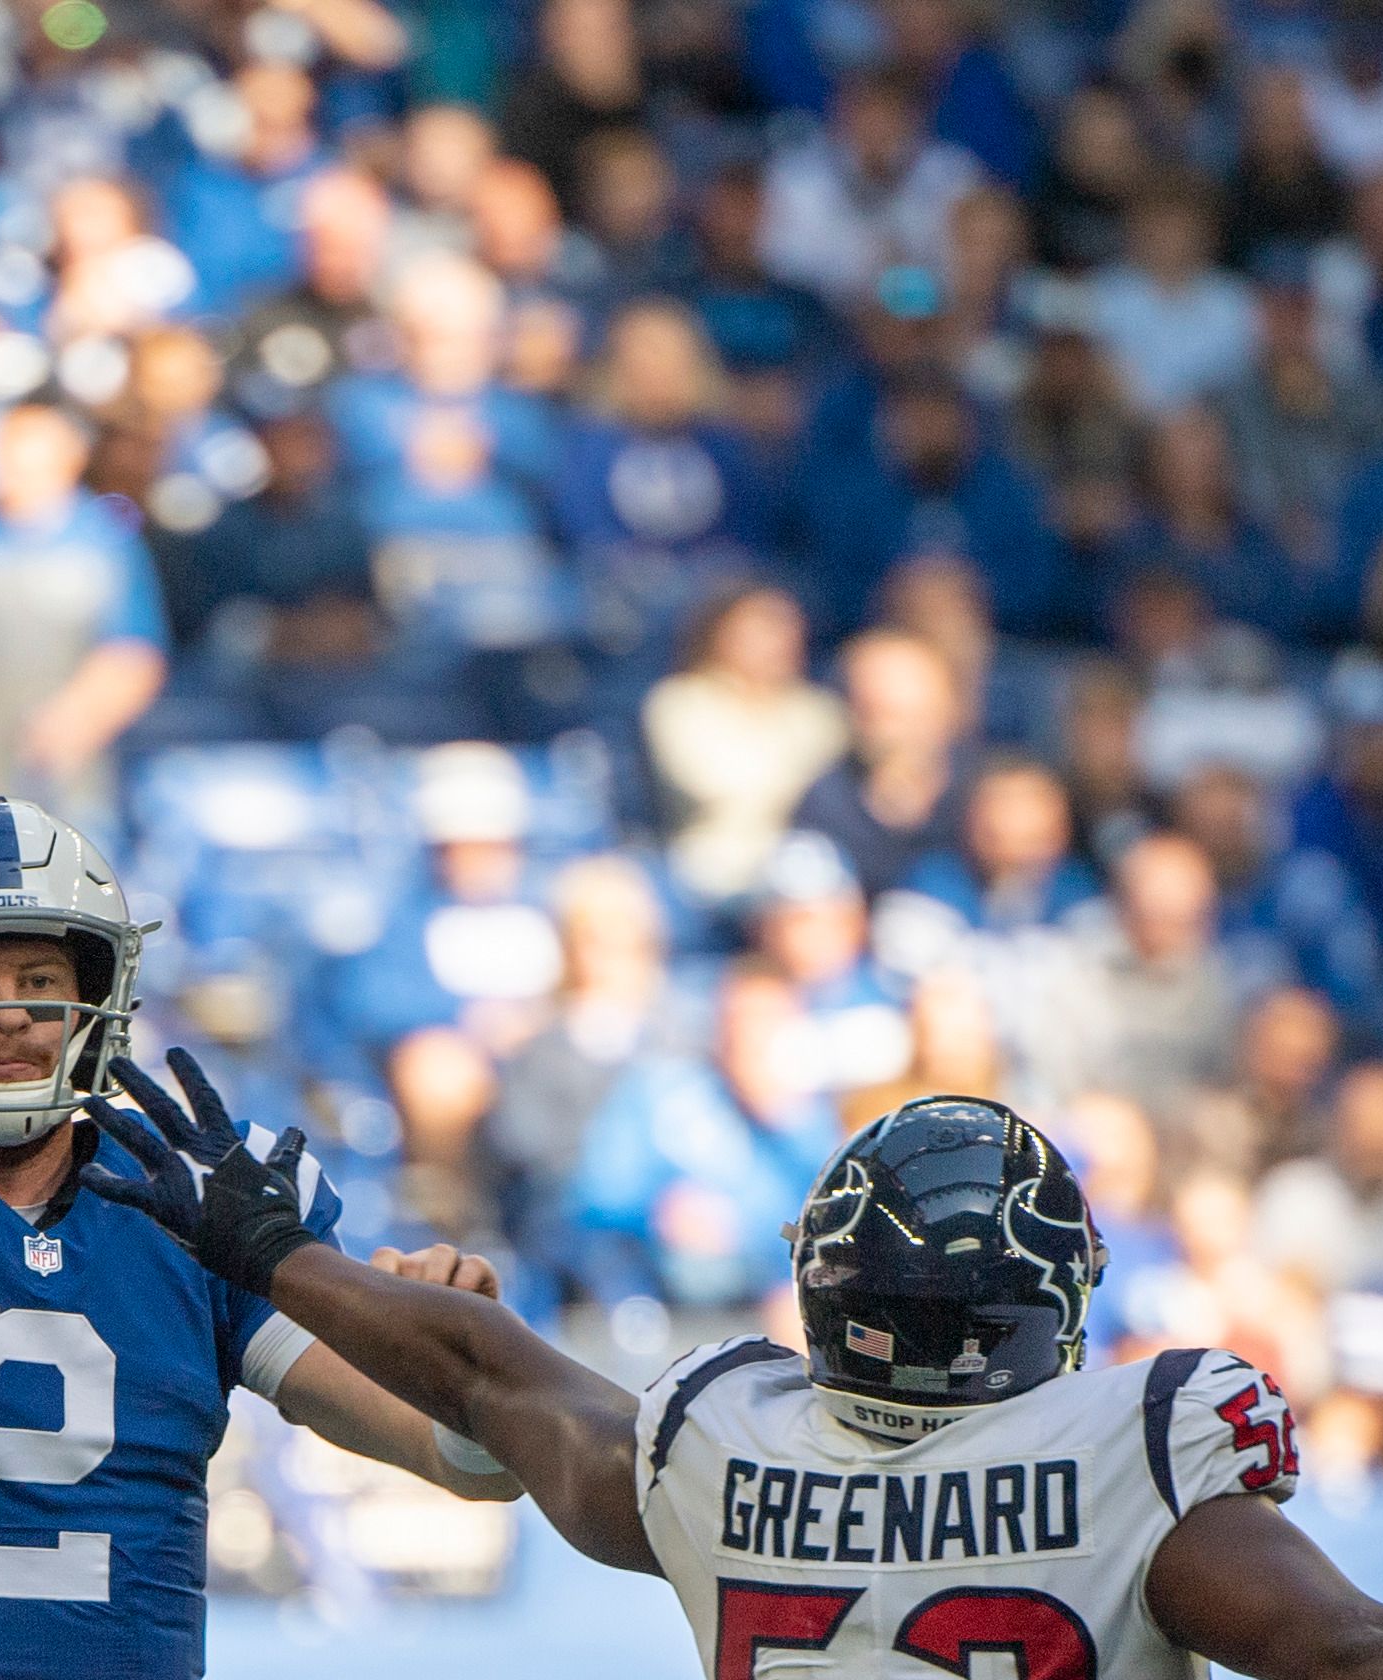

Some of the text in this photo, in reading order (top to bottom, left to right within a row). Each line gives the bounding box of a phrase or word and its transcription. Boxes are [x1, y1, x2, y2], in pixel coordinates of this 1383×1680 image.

[854, 1404, 965, 1432] STOP HA
[721, 1457, 1081, 1564] GREENARD
